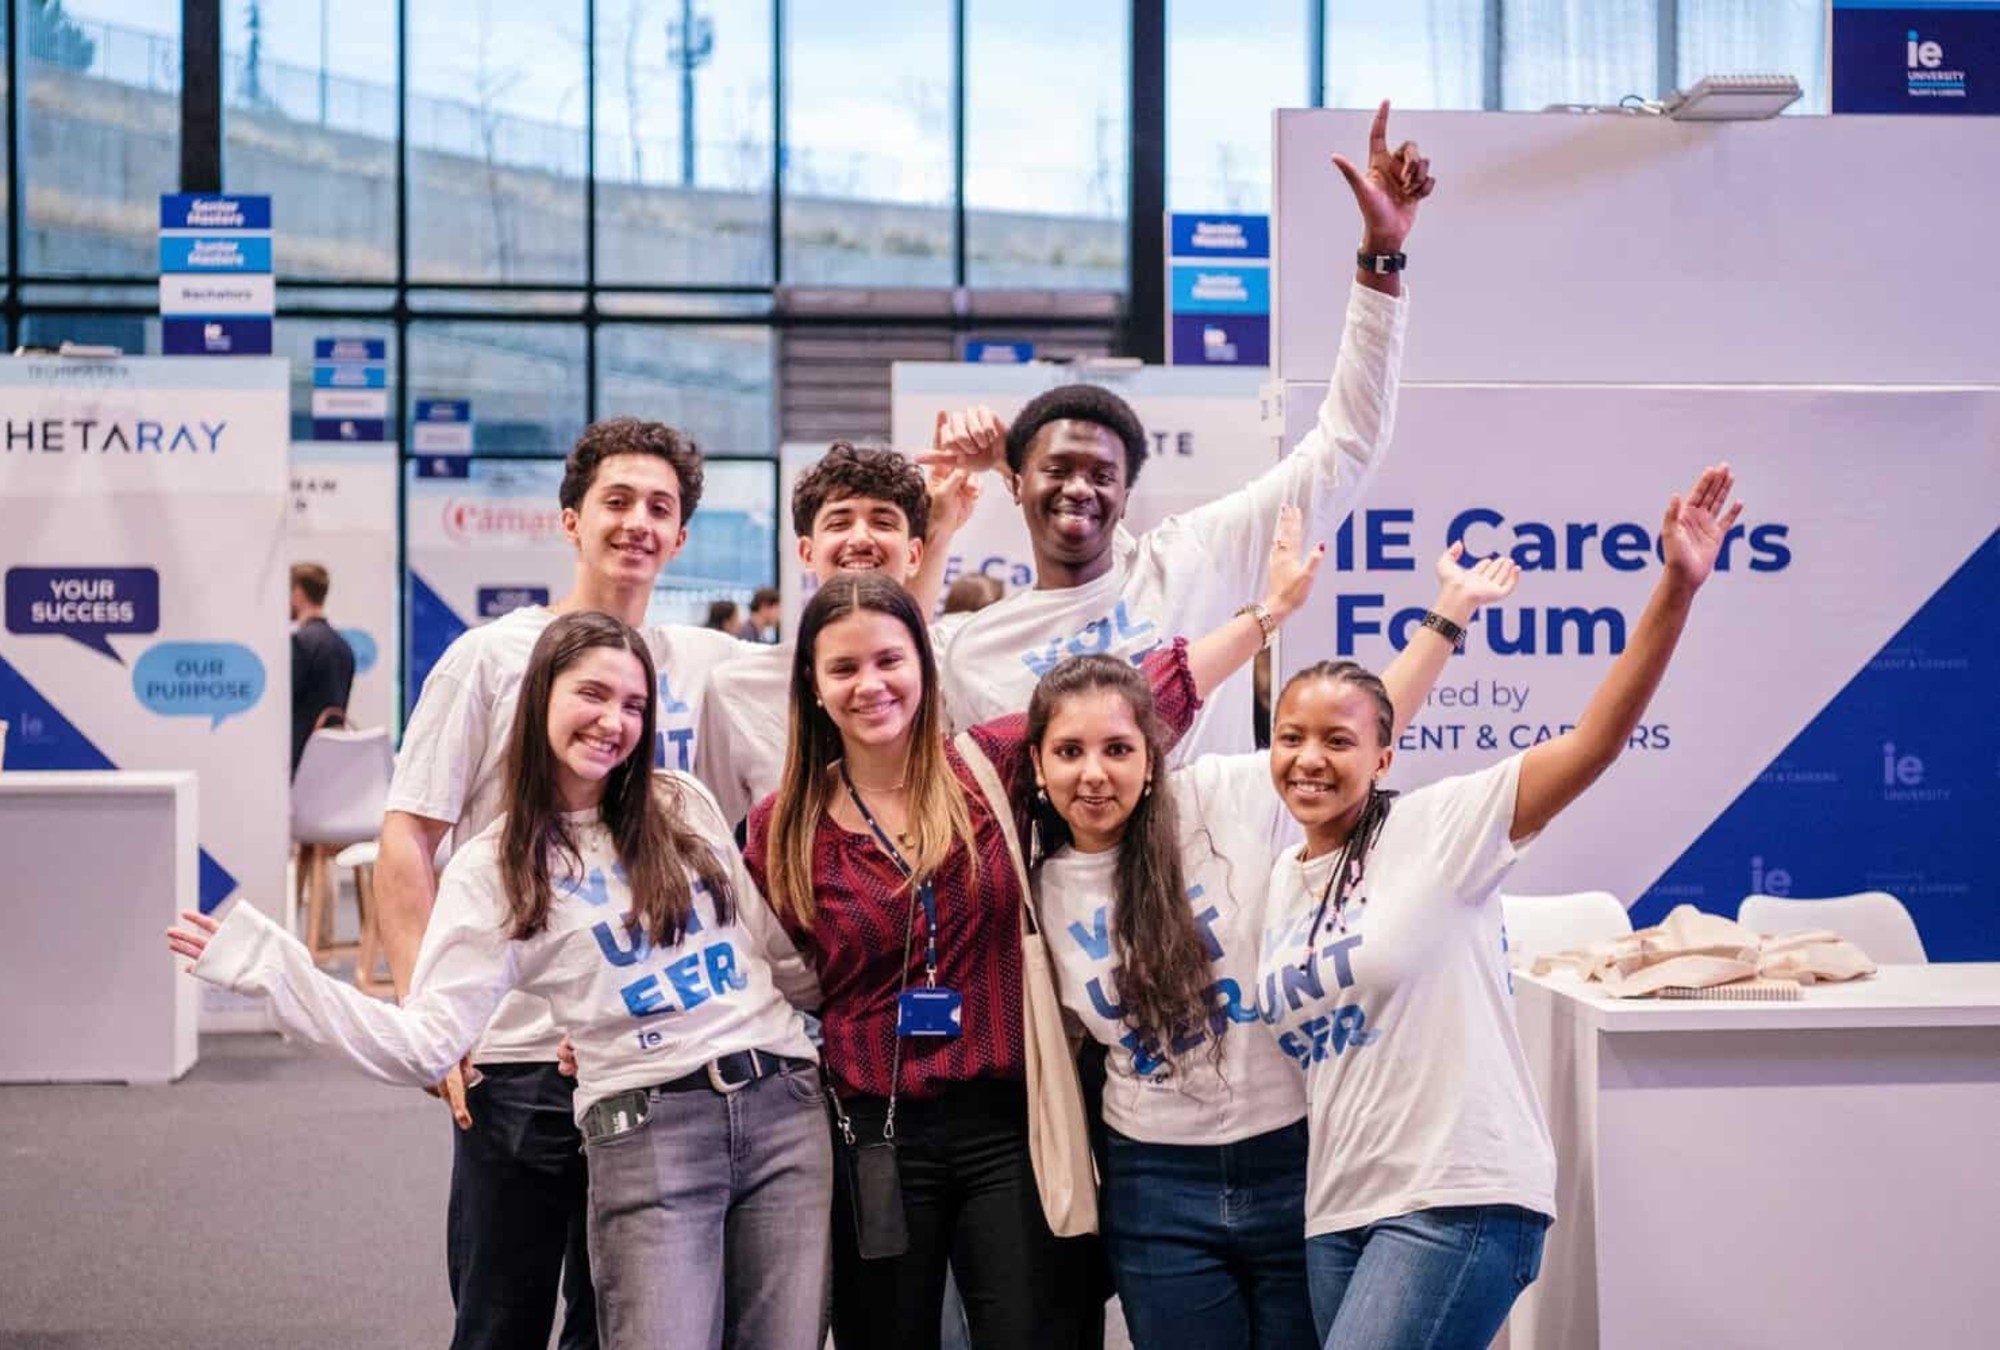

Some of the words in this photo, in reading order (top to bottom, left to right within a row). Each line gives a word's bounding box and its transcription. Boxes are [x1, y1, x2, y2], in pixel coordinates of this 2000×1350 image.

[1908, 29, 1942, 68] ie
[1336, 509, 1415, 571] IE
[1446, 508, 1792, 573] Carers
[51, 579, 115, 600] YOUR
[31, 601, 134, 623] SUCCESS
[175, 658, 224, 677] OUR
[147, 680, 252, 699] PURPOSE
[1492, 681, 1531, 713] by
[1476, 724, 1498, 750] &
[1509, 723, 1672, 750] CARS
[1884, 742, 1924, 785] ie
[1751, 856, 1792, 897] ie
[621, 942, 747, 1016] EER
[1256, 934, 1363, 1025] UNT
